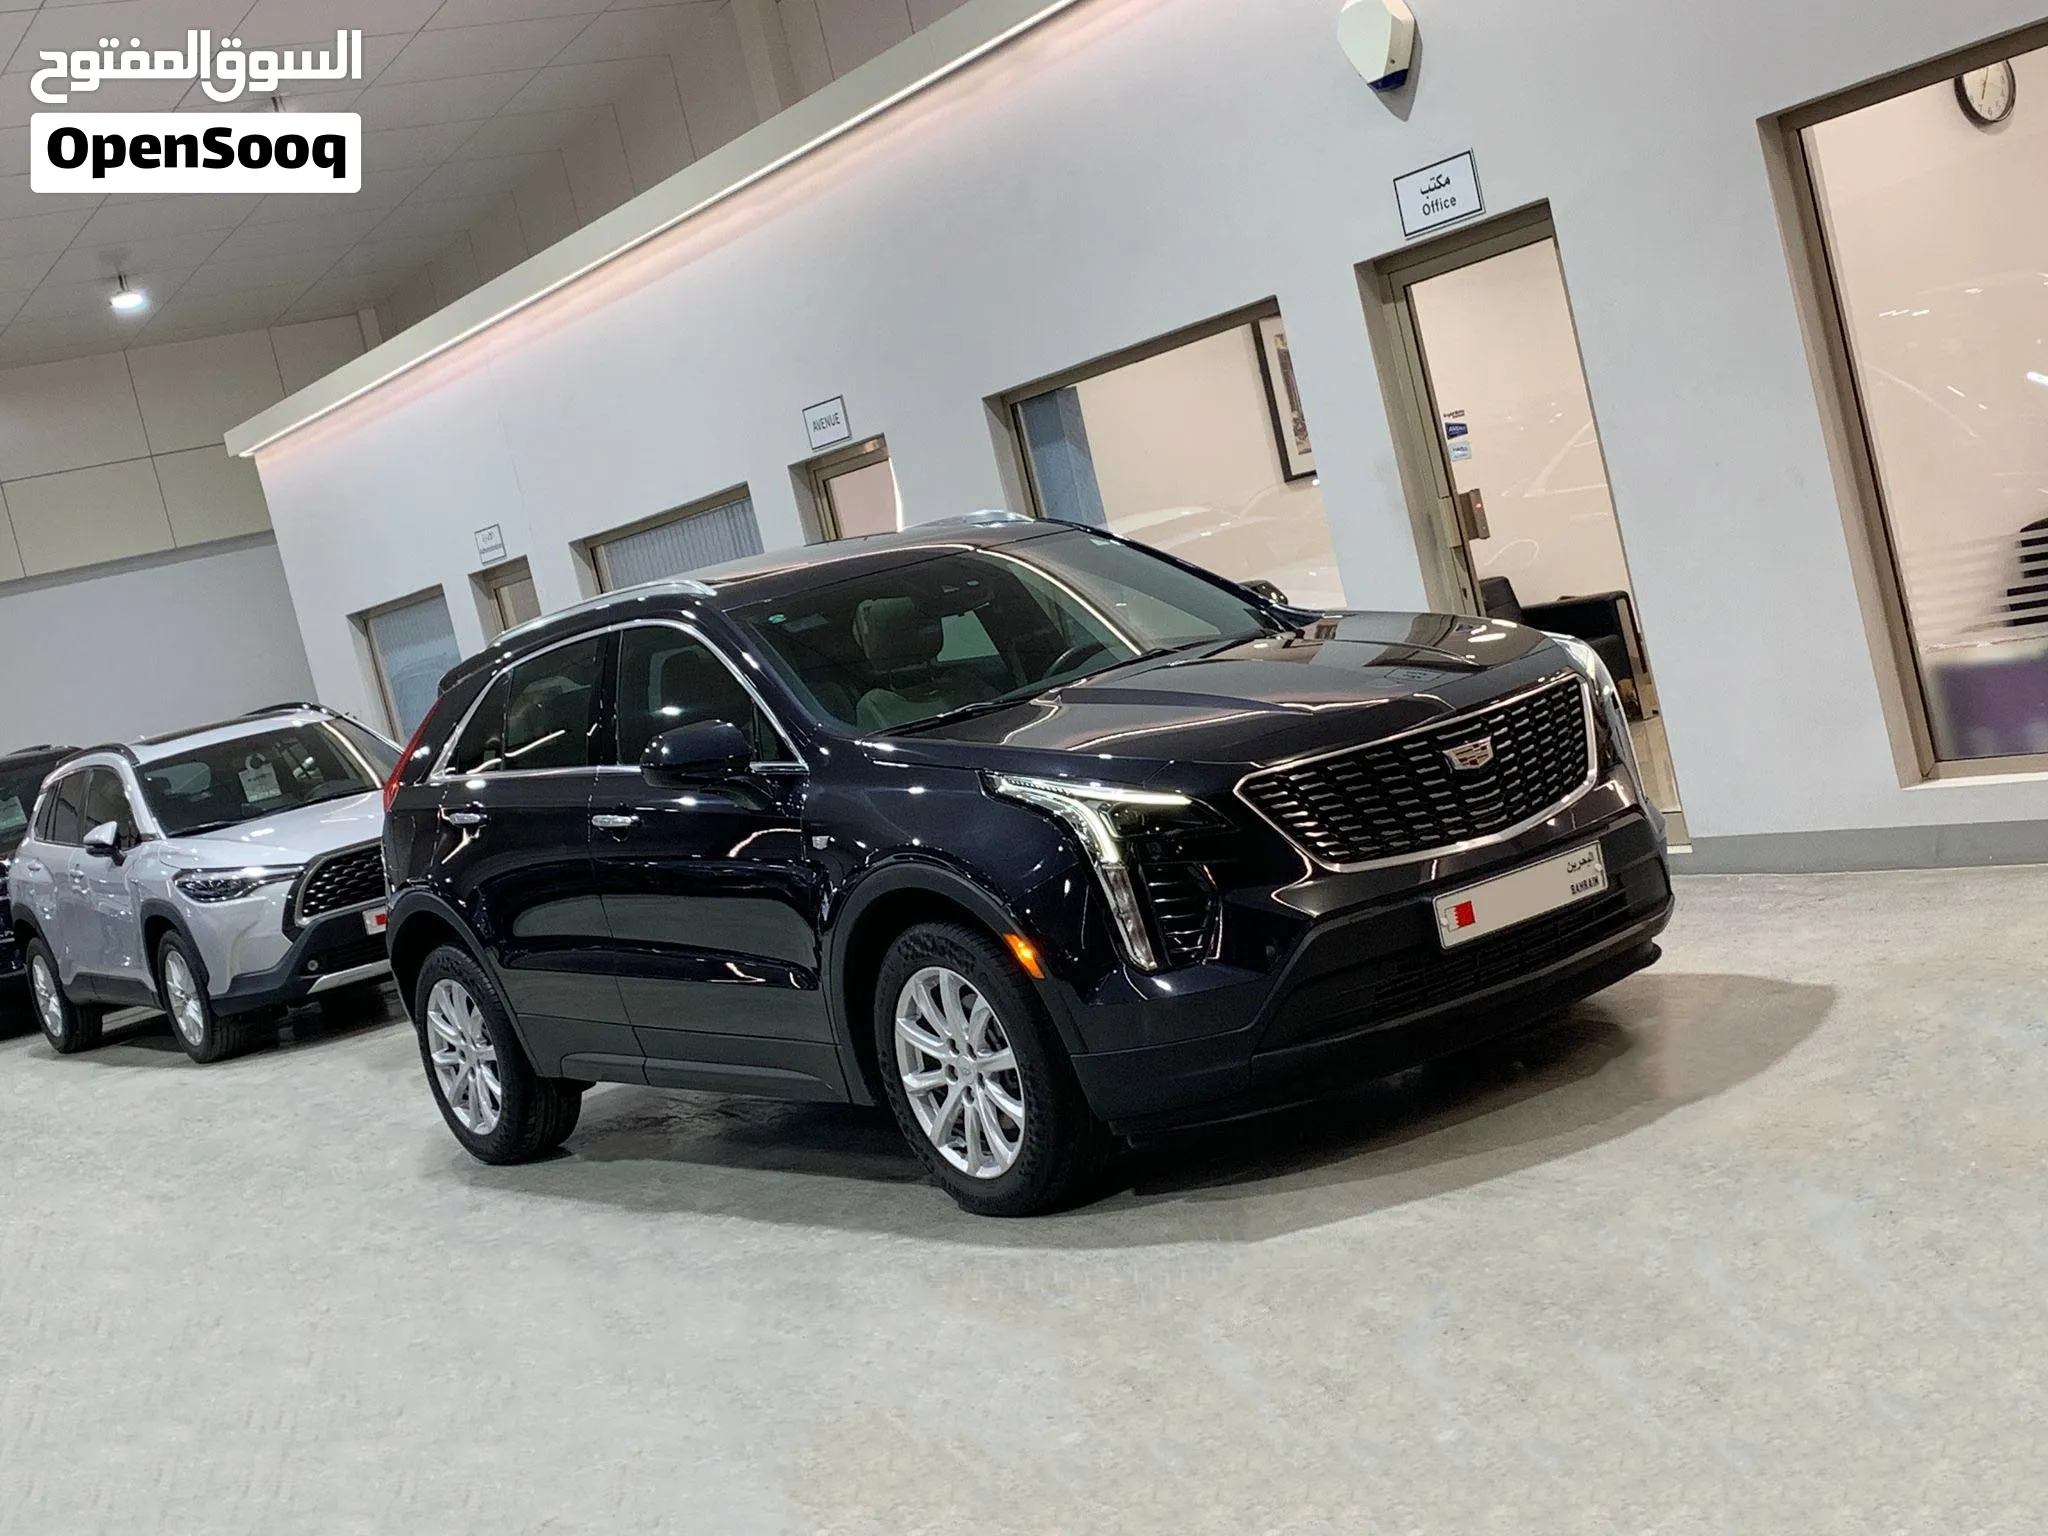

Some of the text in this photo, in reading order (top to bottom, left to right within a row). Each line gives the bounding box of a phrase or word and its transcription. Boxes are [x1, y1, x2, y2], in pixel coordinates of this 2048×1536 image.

[1420, 174, 1451, 199] مكتب
[1422, 196, 1456, 216] Office
[1567, 852, 1594, 873] البحرين
[1570, 875, 1599, 895] BAHRAIN
